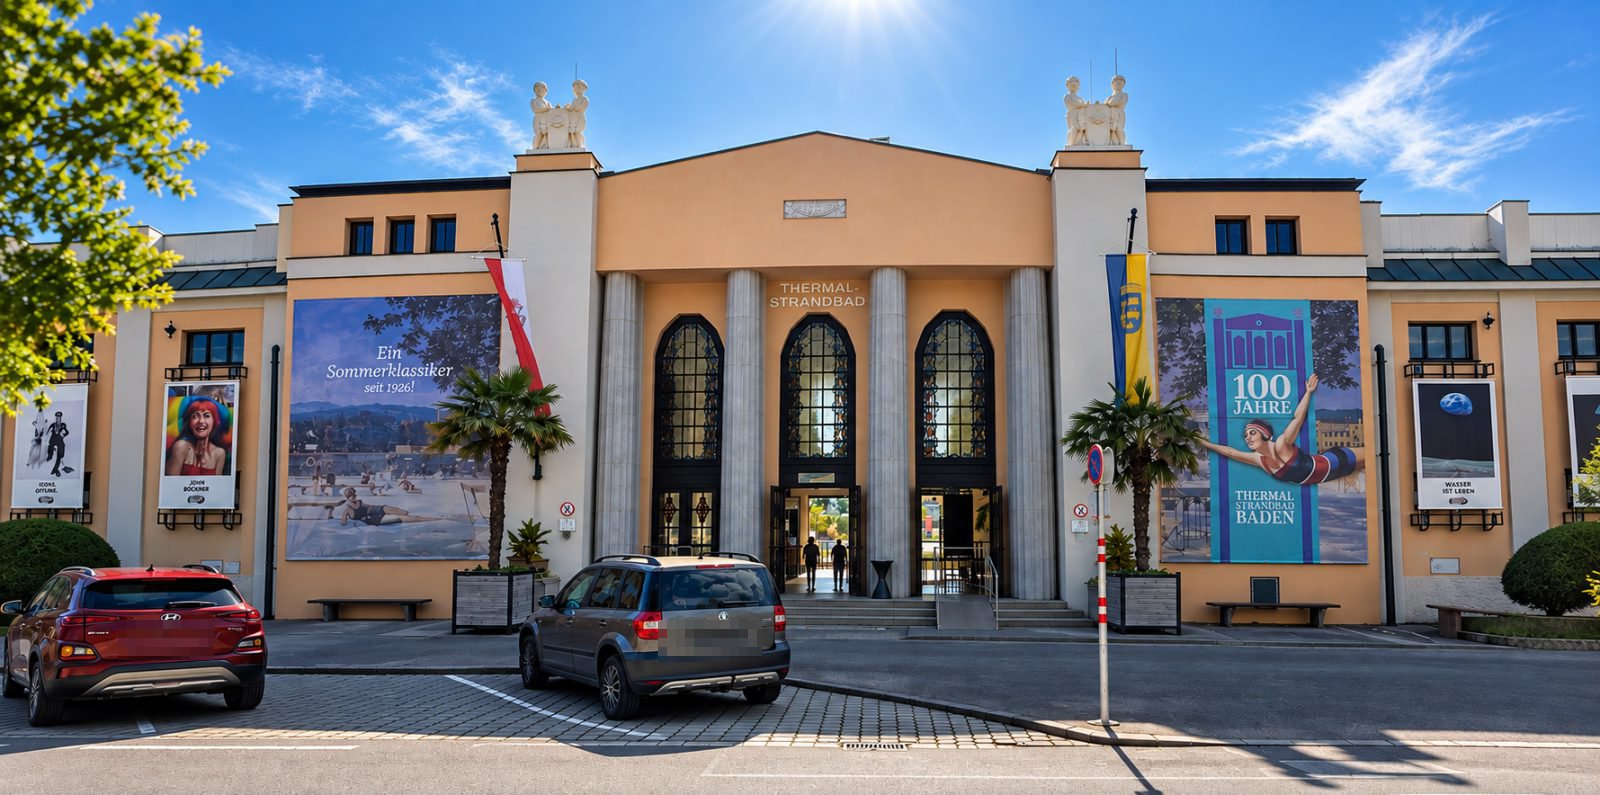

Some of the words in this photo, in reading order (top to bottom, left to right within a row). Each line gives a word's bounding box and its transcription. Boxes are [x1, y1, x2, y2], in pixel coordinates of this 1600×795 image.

[780, 282, 859, 293] THERMAL-
[770, 296, 865, 308] STRANDBAD
[376, 346, 402, 360] Ein
[326, 363, 453, 378] Sommerklassiker
[364, 382, 384, 392] seit
[387, 381, 415, 393] 1926!
[1233, 374, 1291, 400] 100
[1234, 400, 1292, 414] JAHRE
[1235, 490, 1294, 500] THERMAL
[1236, 501, 1294, 510] STRANDBAD
[1236, 510, 1294, 524] BADEN
